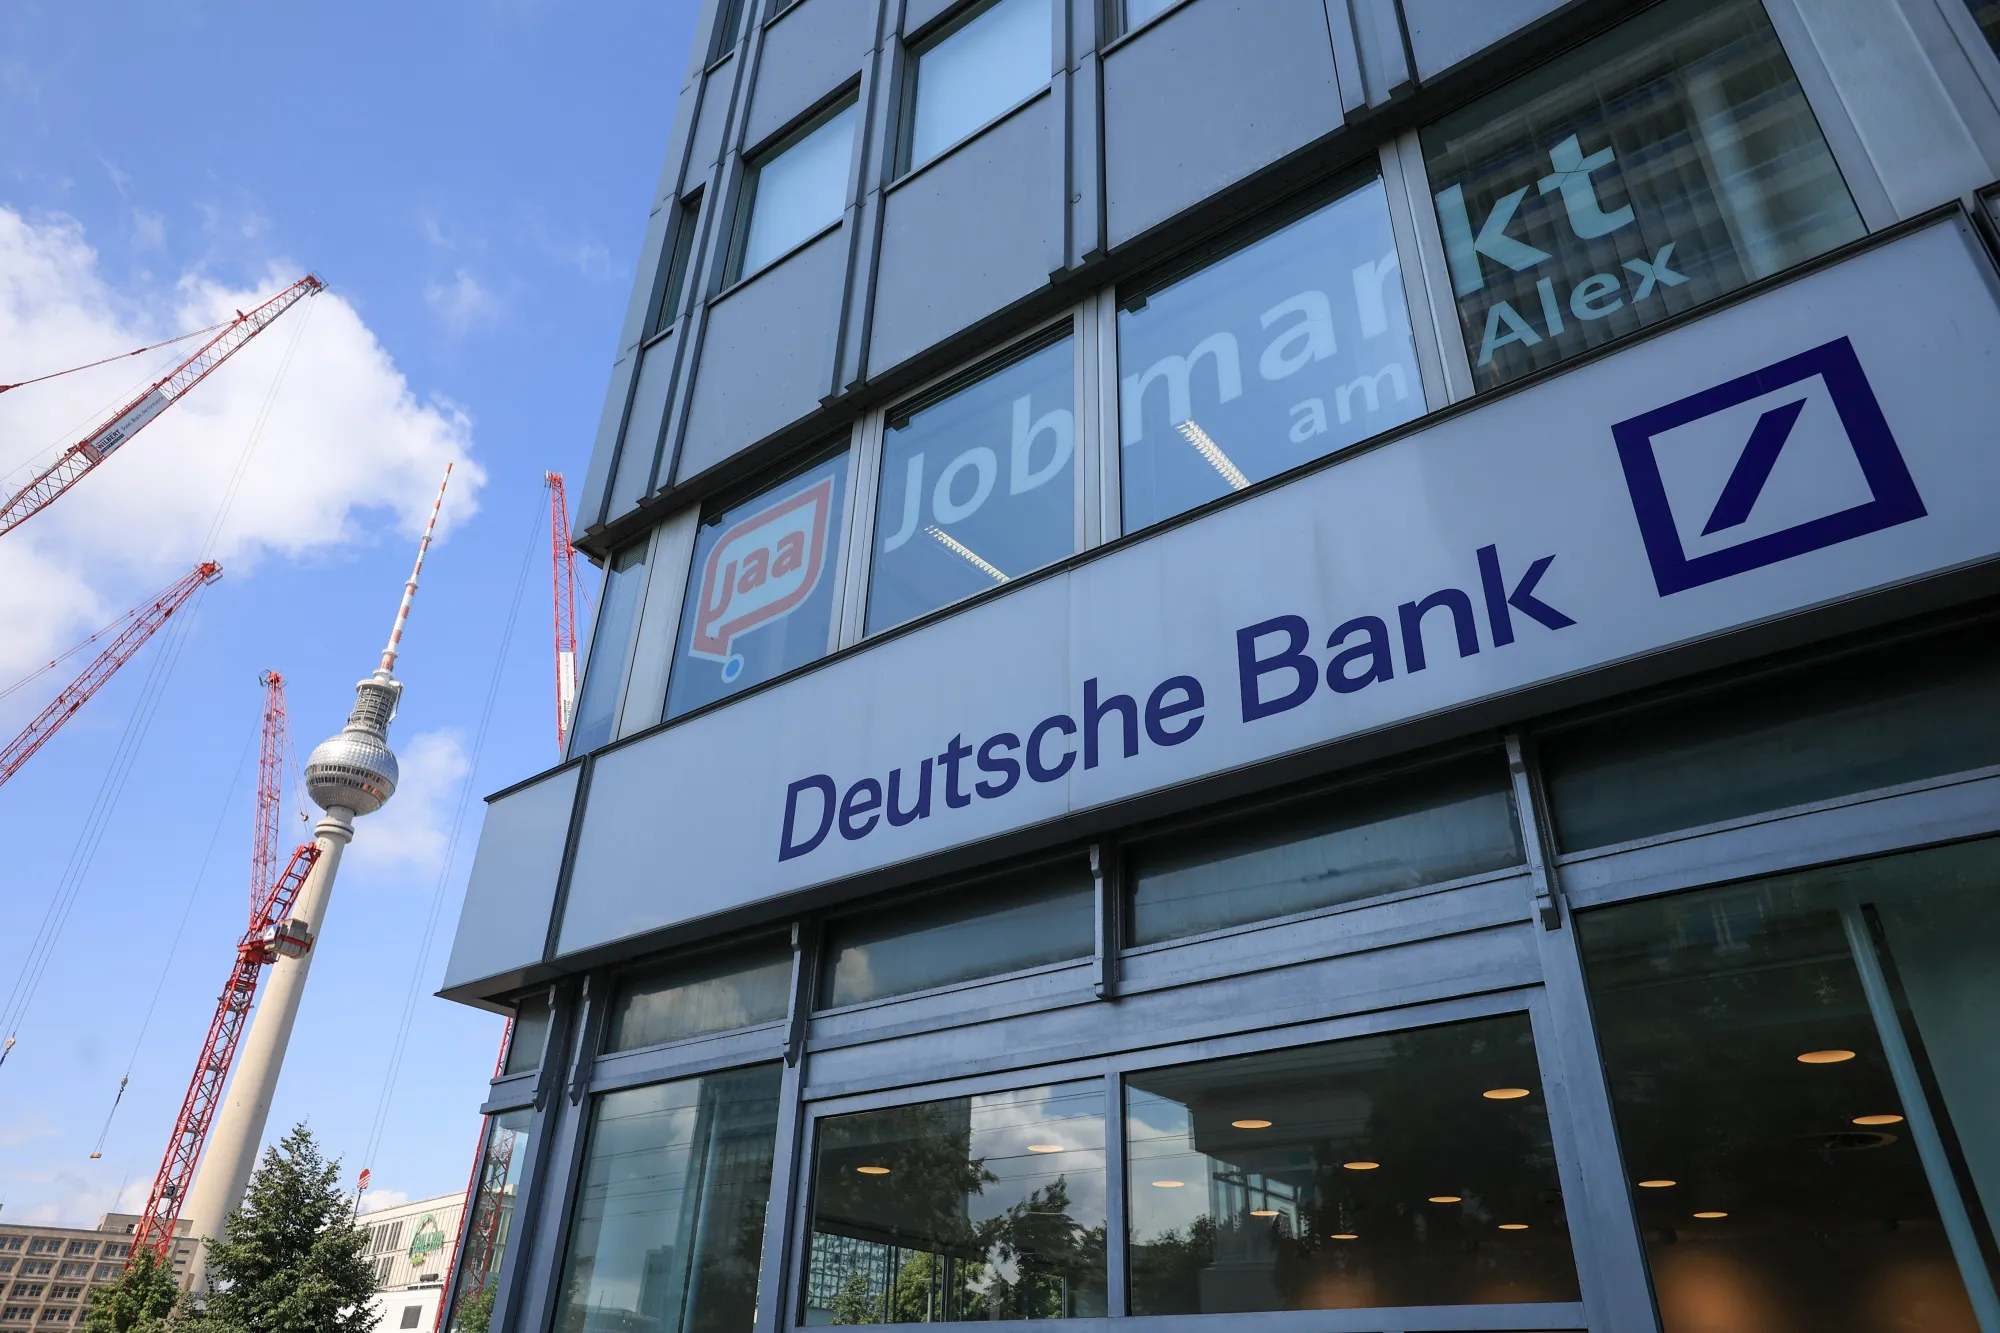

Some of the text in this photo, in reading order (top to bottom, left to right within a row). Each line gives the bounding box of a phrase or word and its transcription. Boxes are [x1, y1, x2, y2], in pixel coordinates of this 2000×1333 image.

[1287, 241, 1690, 444] am Alex
[96, 429, 121, 450] WILBERT
[777, 543, 1578, 864] Deutsche Bank
[167, 1186, 176, 1197] 3
